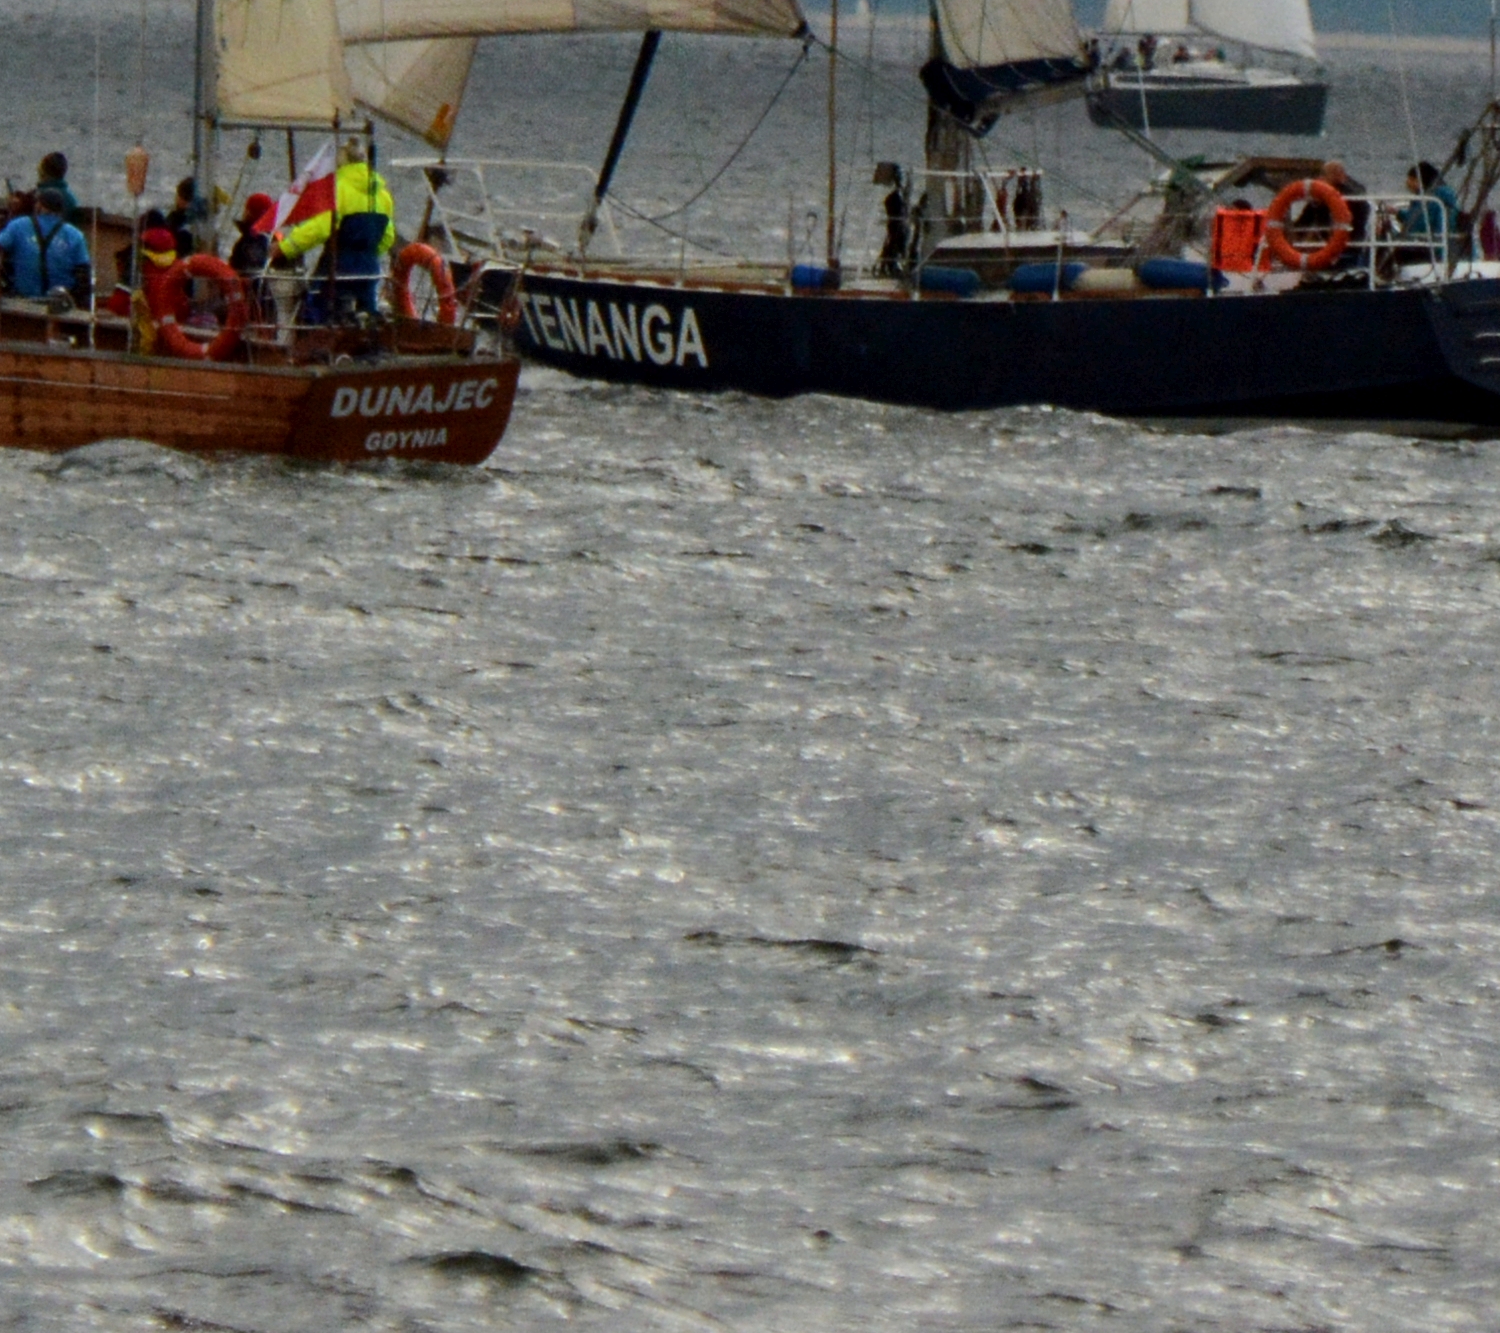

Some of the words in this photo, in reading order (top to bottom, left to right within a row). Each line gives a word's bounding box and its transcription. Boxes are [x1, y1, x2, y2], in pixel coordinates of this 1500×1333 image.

[517, 291, 710, 369] TENANGA
[330, 378, 498, 418] DUNAJEC
[364, 427, 448, 452] GDYNIA
